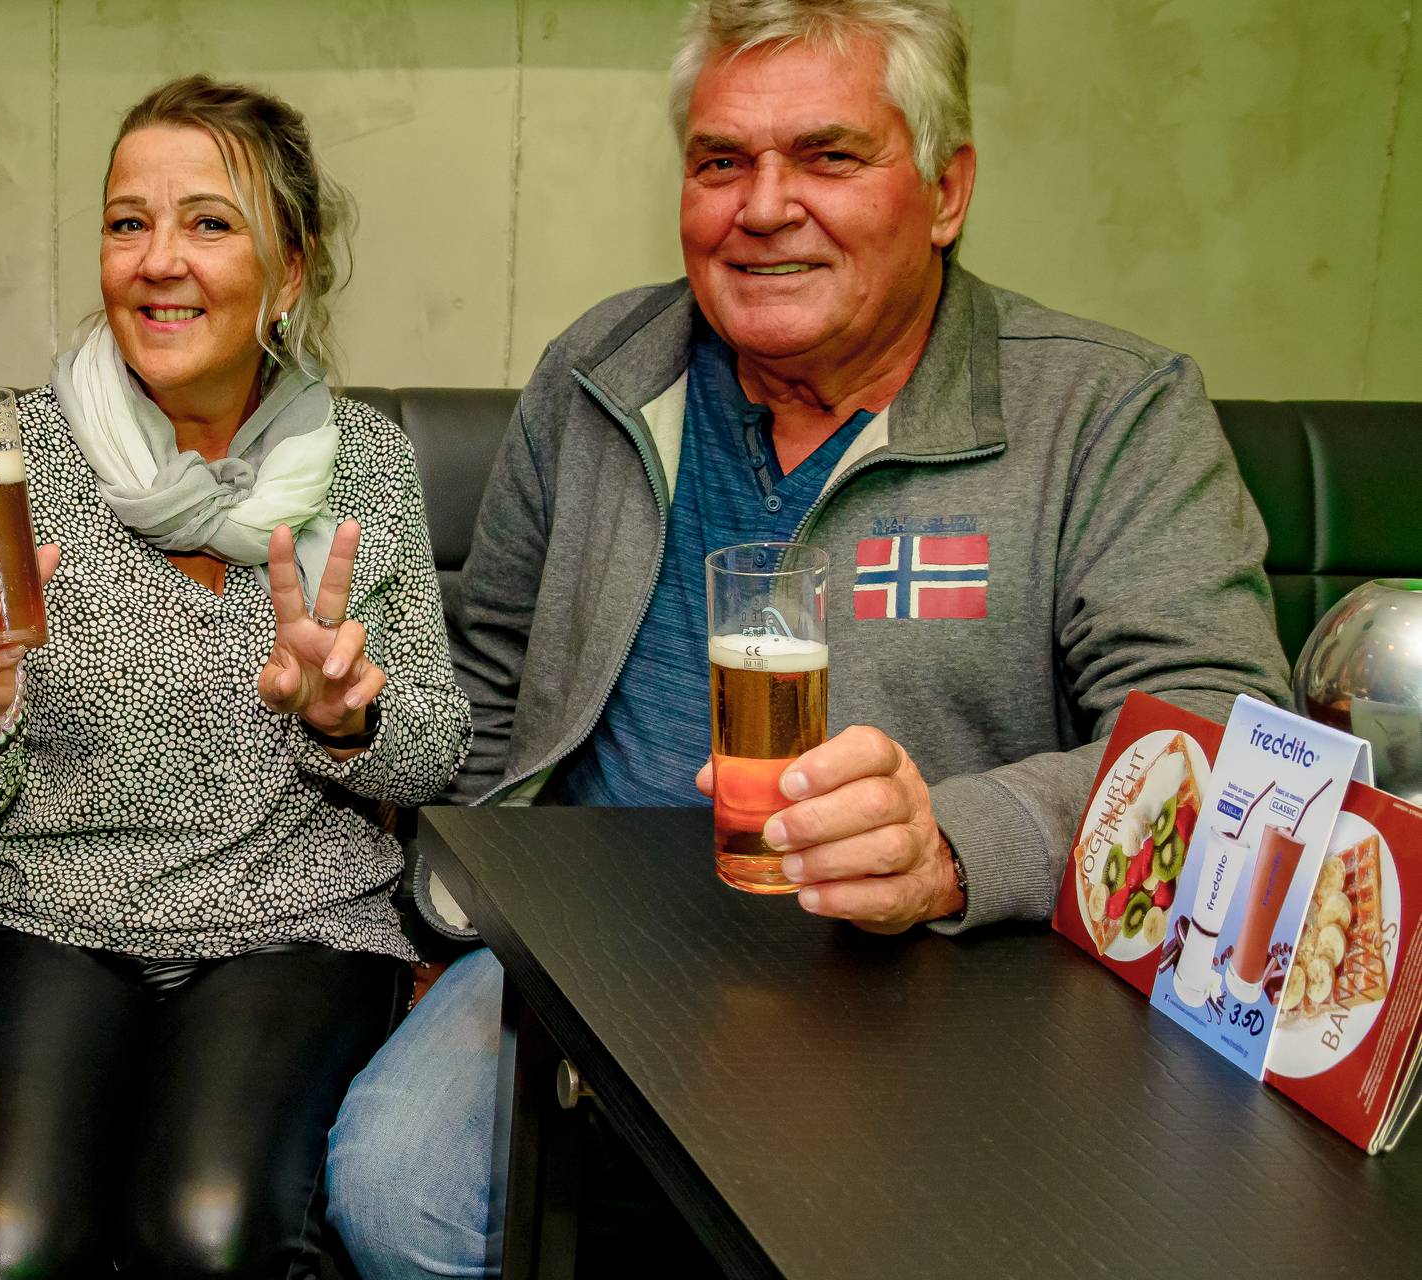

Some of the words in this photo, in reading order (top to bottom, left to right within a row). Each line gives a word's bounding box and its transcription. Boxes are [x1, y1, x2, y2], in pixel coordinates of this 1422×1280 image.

[1250, 723, 1315, 768] freddito
[1103, 747, 1146, 845] FRUCHT
[1271, 802, 1297, 818] CLASSIC
[1080, 768, 1124, 885] JOGHURT
[1206, 854, 1228, 911] freddito
[1229, 1002, 1265, 1037] 3.50
